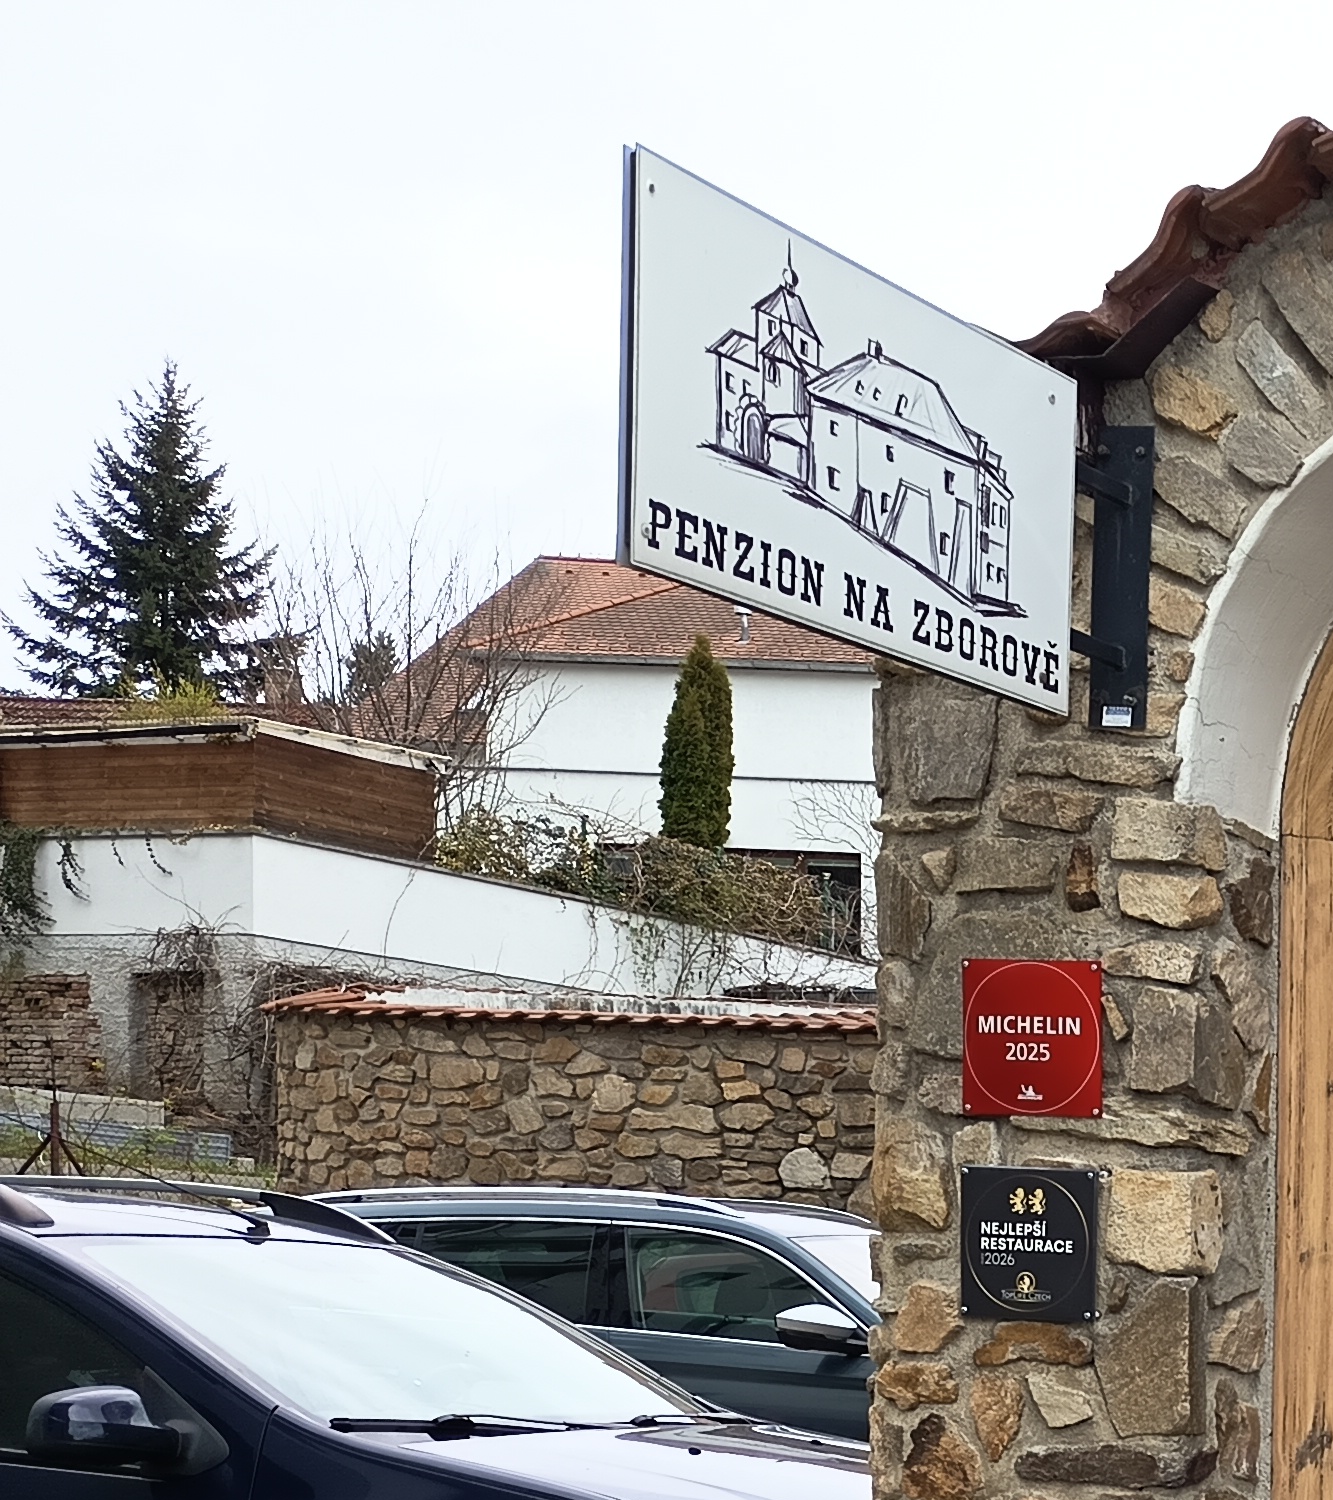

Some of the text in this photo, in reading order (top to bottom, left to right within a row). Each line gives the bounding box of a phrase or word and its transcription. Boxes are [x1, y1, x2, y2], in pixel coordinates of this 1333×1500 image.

[648, 498, 1059, 694] PENZION NA ZBOROVĚ
[978, 1015, 1081, 1035] MICHELIN
[1005, 1042, 1051, 1061] 2025
[980, 1221, 1047, 1237] NEJLEPŠÍ
[980, 1237, 1073, 1253] RESTAURACE
[984, 1252, 1015, 1266] 2026
